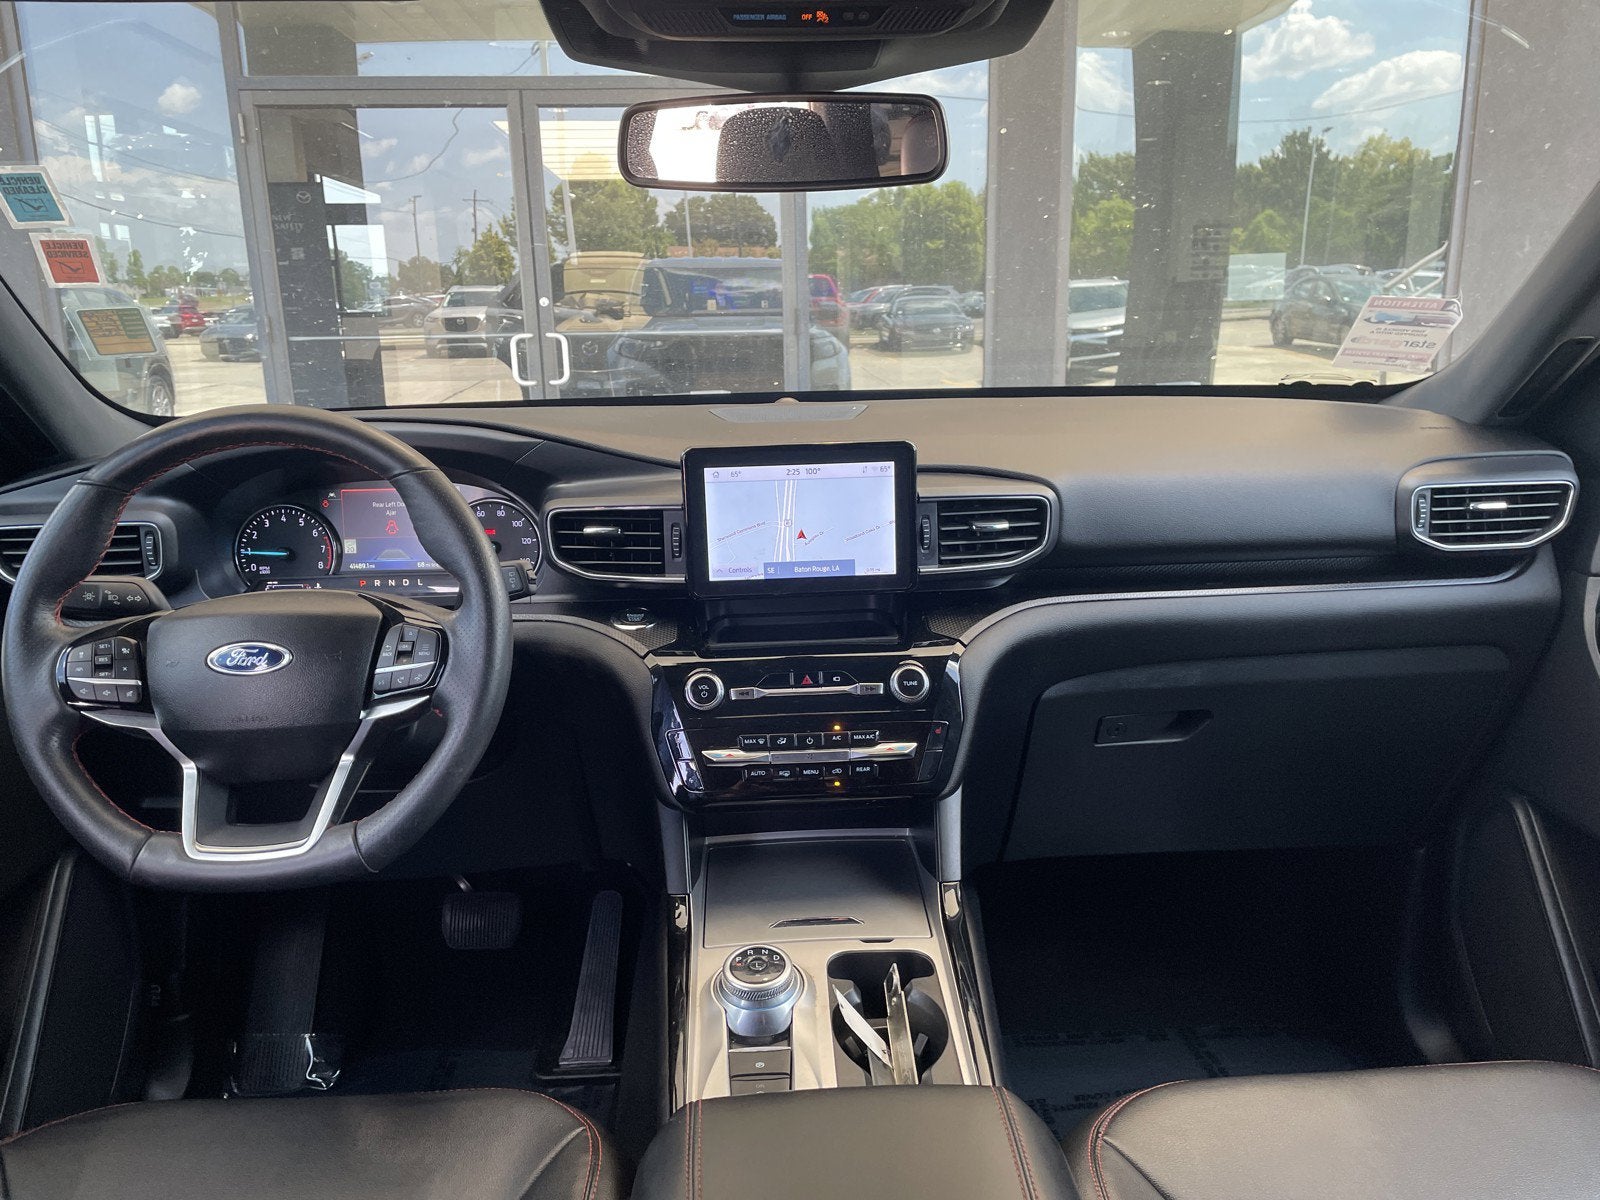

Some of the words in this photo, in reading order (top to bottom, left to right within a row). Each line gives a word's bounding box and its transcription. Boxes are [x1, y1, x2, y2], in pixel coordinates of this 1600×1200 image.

[786, 468, 800, 476] 2:25
[280, 514, 286, 522] 4
[298, 518, 305, 526] 5
[263, 519, 270, 527] 3
[252, 531, 257, 539] 2
[312, 529, 318, 537] 6
[321, 545, 326, 553] 7
[250, 563, 257, 571] 0
[318, 561, 324, 569] 8
[812, 565, 832, 573] Rouge,
[359, 579, 367, 587] P
[402, 578, 409, 586] D
[417, 578, 423, 586] L
[226, 648, 269, 667] Ford
